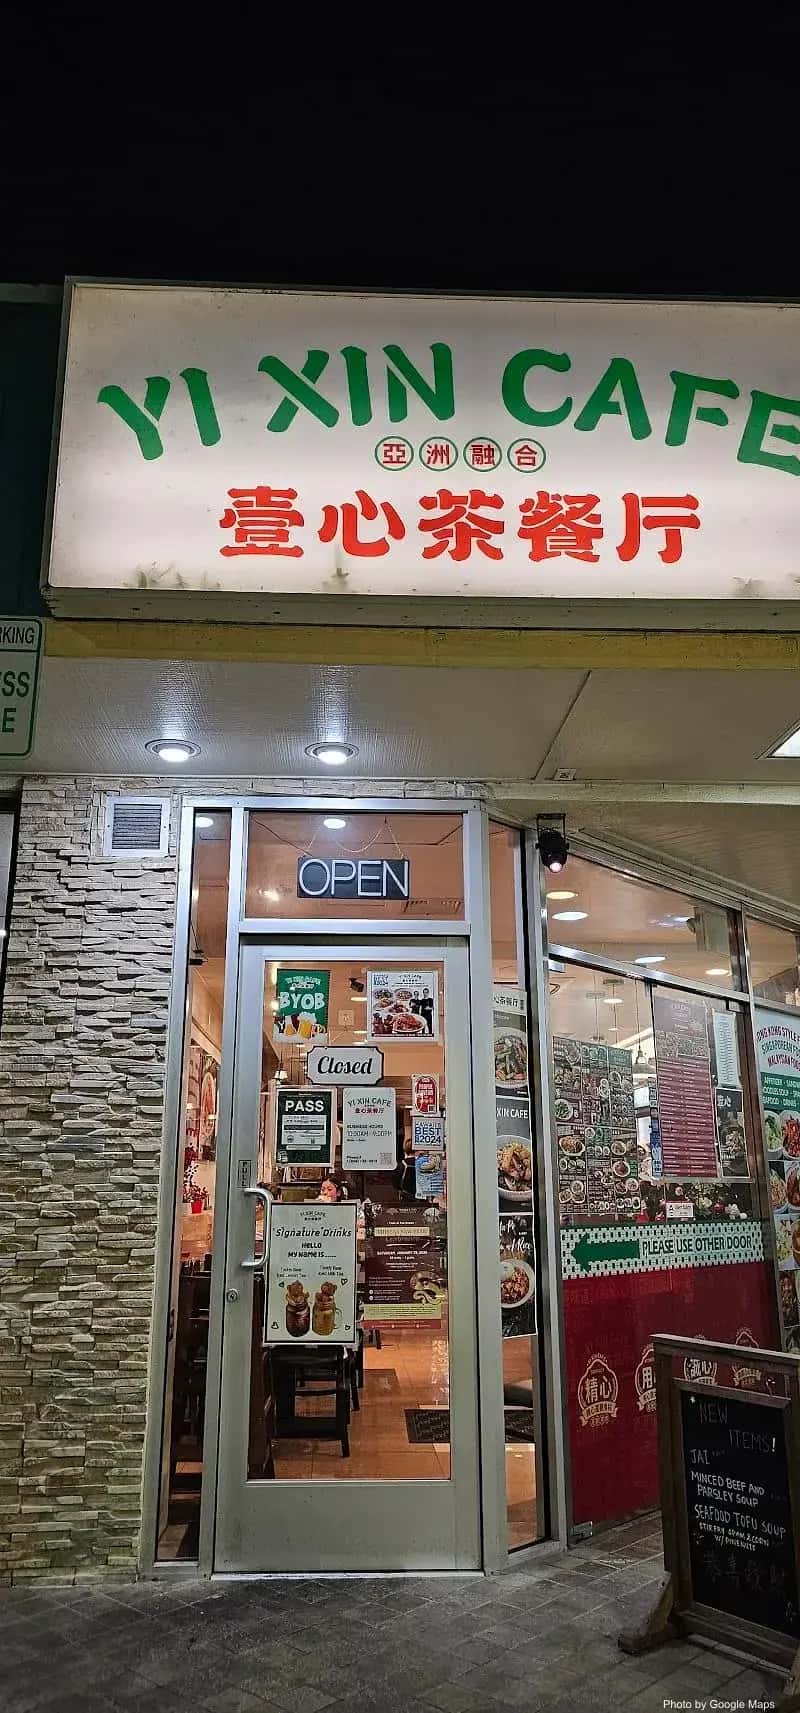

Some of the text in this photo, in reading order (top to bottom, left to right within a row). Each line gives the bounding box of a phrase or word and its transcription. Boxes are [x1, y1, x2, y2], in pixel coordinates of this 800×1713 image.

[98, 342, 800, 476] YI XIN CAFE
[382, 442, 539, 467] 亞洲融合
[219, 486, 701, 563] 壹心茶餐厅
[0, 671, 30, 697] SS
[300, 858, 409, 897] OPEN
[280, 991, 325, 1010] BYOB
[782, 1027, 797, 1042] STYLE
[317, 1056, 373, 1074] Closed
[285, 1100, 324, 1112] PASS
[496, 1106, 528, 1119] XIN CAFE
[415, 1127, 441, 1136] BEST
[420, 1135, 441, 1143] 2024
[275, 1226, 352, 1239] Signature Drinks
[642, 1236, 752, 1258] PLEASE USE OTHER DOOR
[585, 1376, 612, 1404] 精心
[699, 1403, 728, 1424] NEW
[729, 1428, 776, 1453] ITEMS!
[691, 1470, 766, 1496] MINCED BEEF AND
[697, 1484, 758, 1507] PARSLEY SOUP
[694, 1503, 787, 1540] SEAFOOD TOFU SOUP
